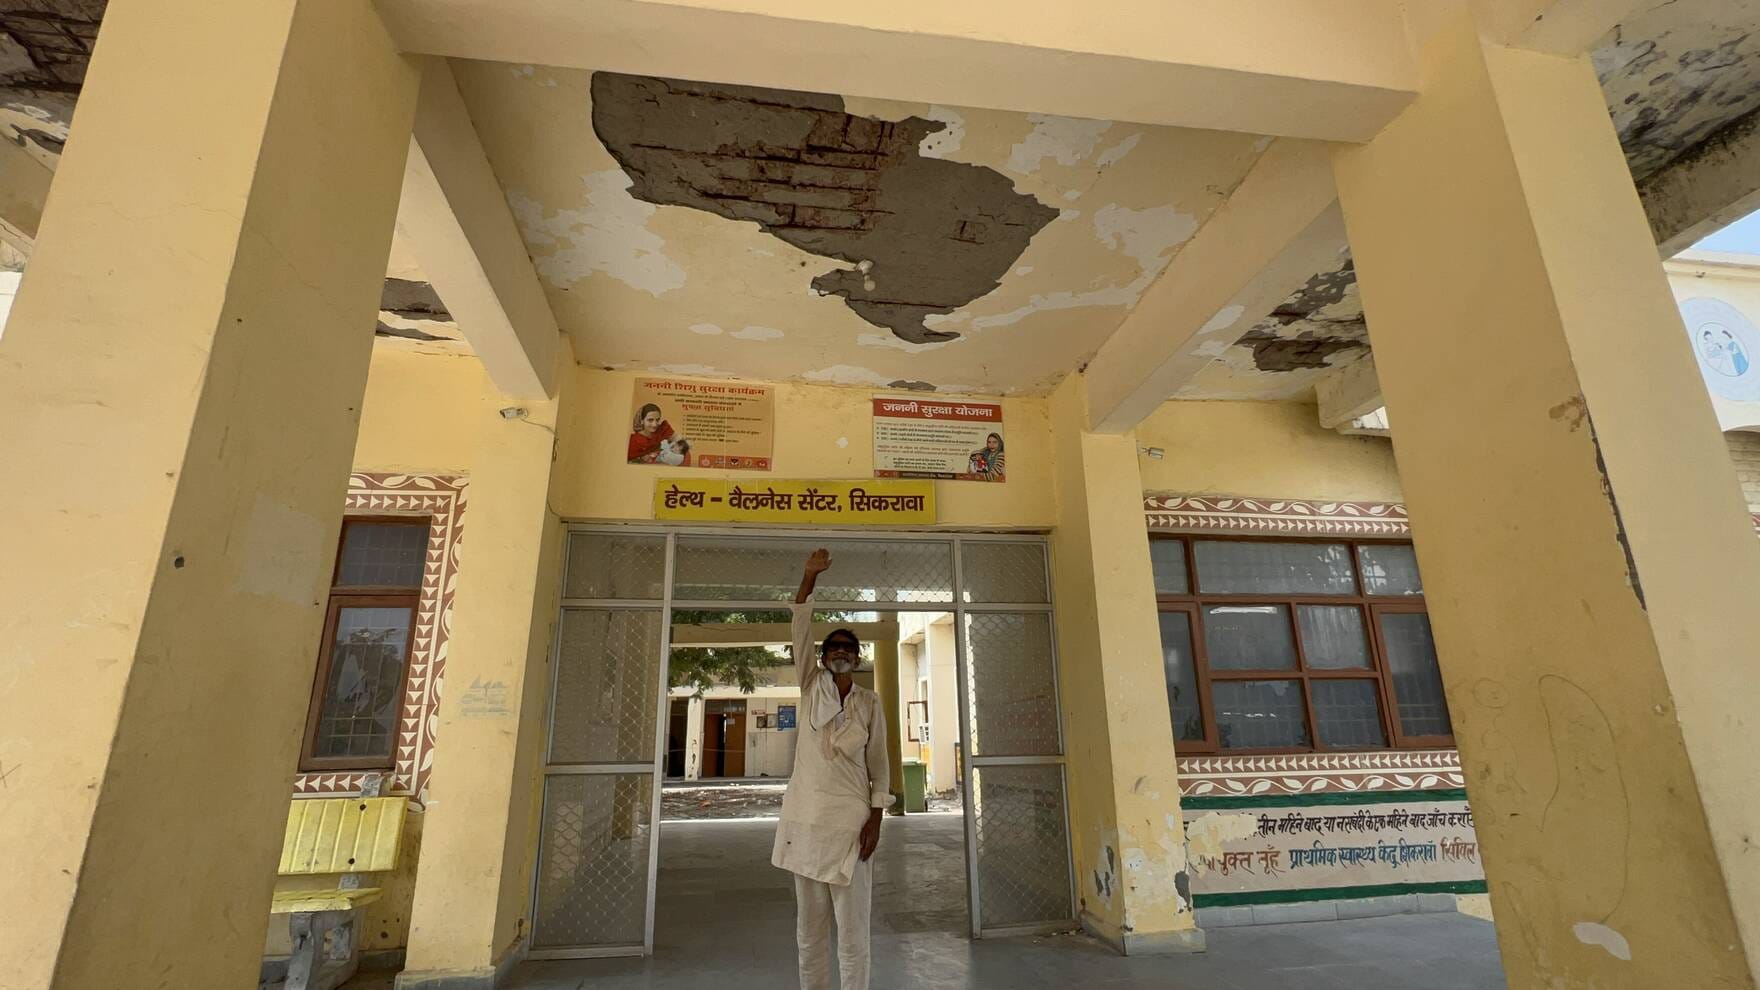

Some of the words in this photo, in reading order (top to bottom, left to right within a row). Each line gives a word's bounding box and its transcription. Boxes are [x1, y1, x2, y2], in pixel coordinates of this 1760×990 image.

[675, 383, 696, 393] शिशु
[699, 386, 725, 395] सुरक्षा
[883, 402, 918, 413] जननी
[922, 405, 951, 418] सुरक्षा
[955, 405, 993, 417] योजना
[664, 484, 706, 509] हेल्थ
[728, 485, 793, 510] वैलनेस
[797, 487, 842, 513] सेंटर,
[849, 487, 925, 512] सिकरावा
